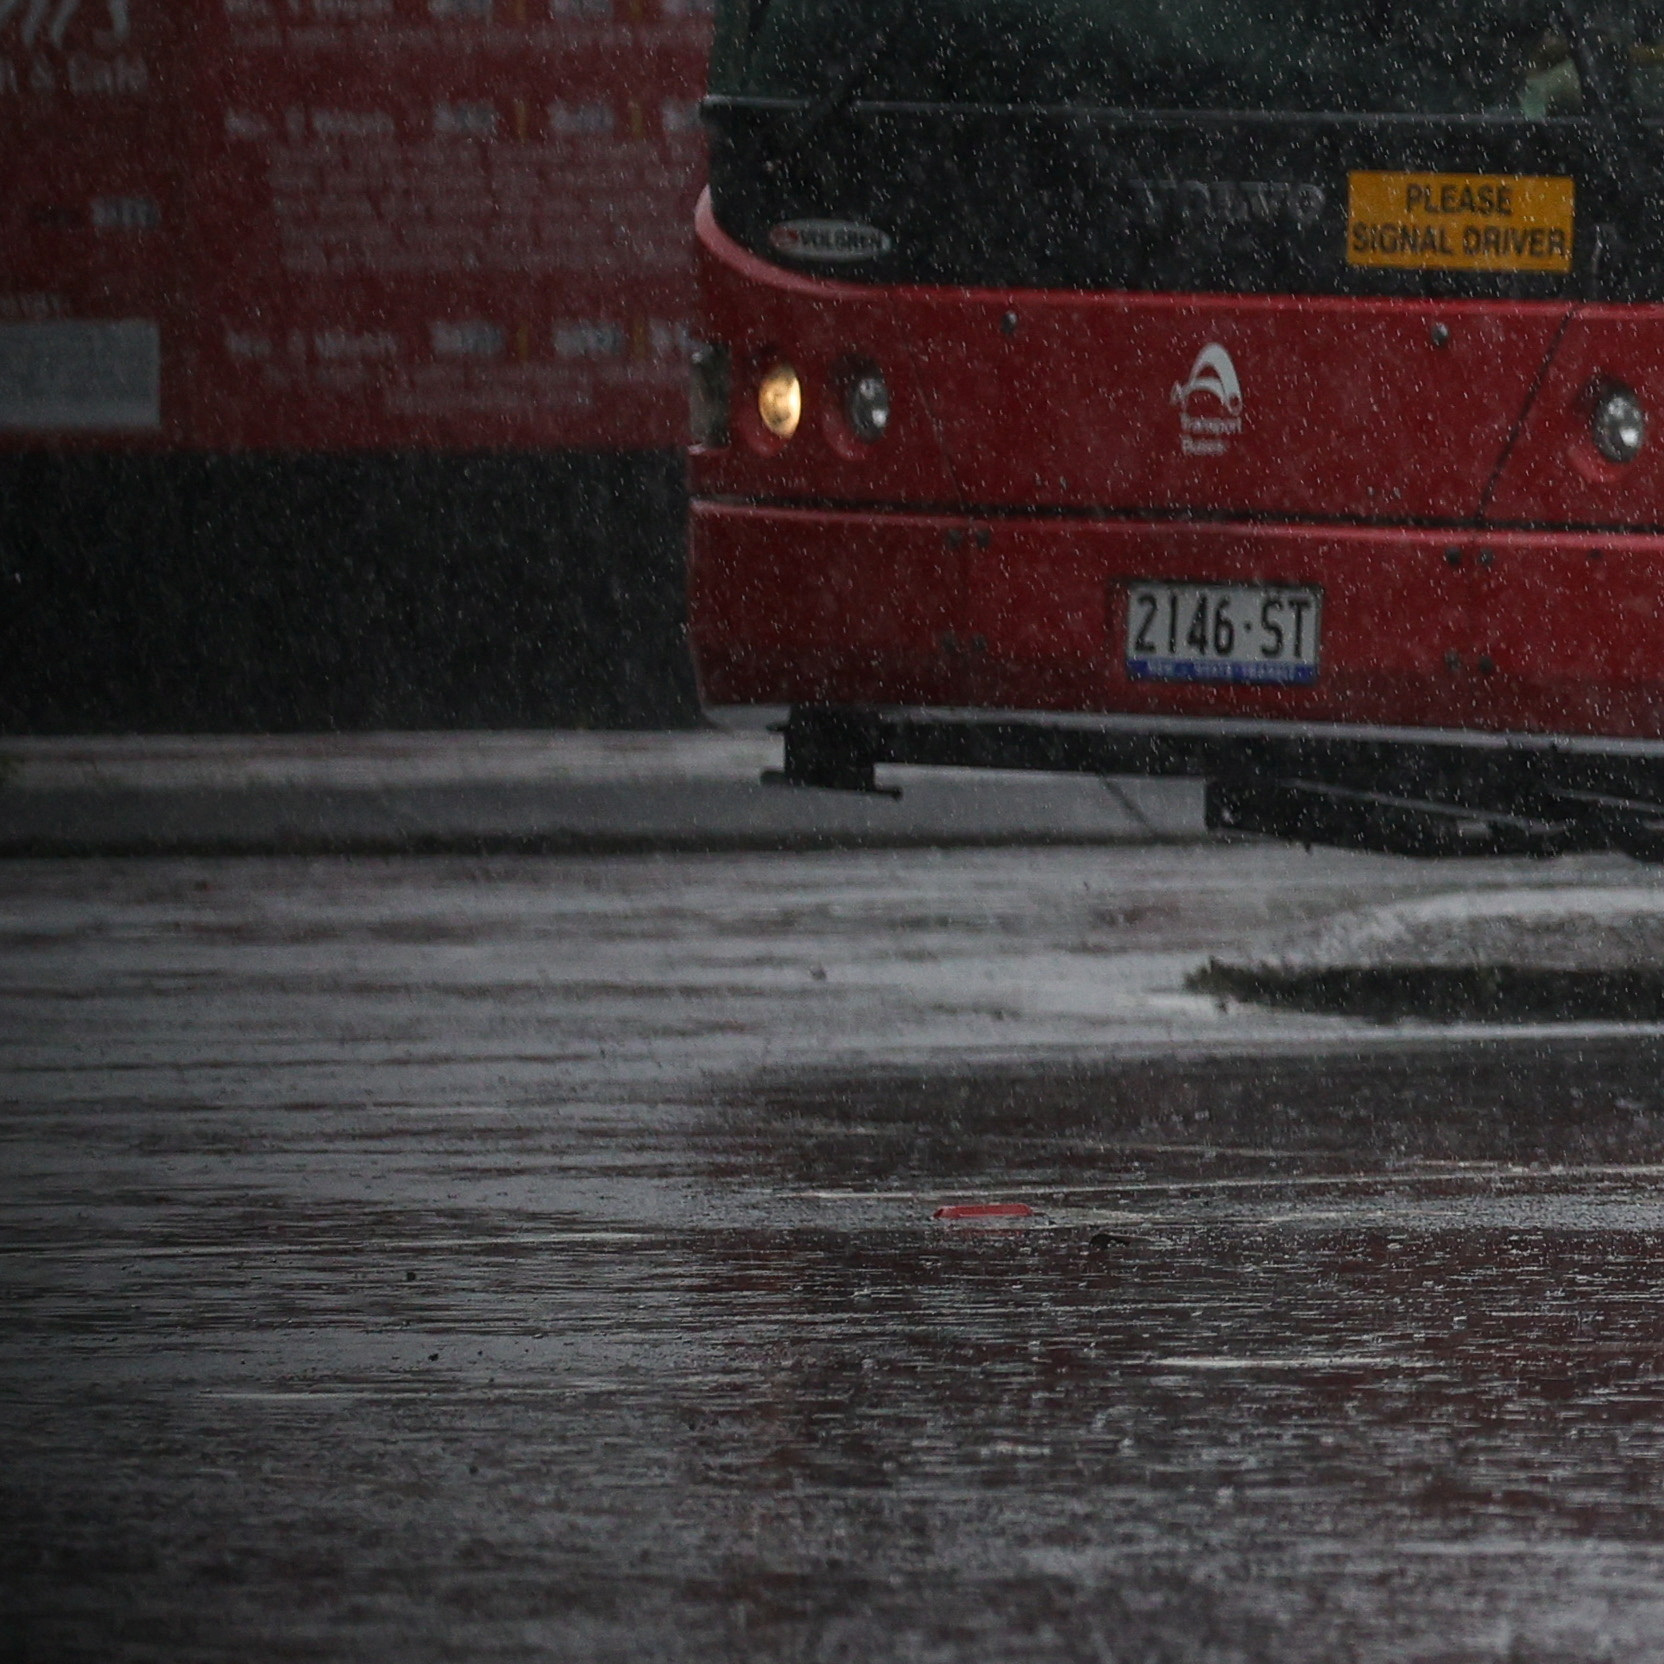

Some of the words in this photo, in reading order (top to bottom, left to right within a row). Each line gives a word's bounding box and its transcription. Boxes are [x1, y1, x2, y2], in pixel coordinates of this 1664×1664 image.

[1405, 183, 1513, 216] PLEASE
[1352, 222, 1453, 255] SIGNAL
[1462, 225, 1567, 258] DRIVER
